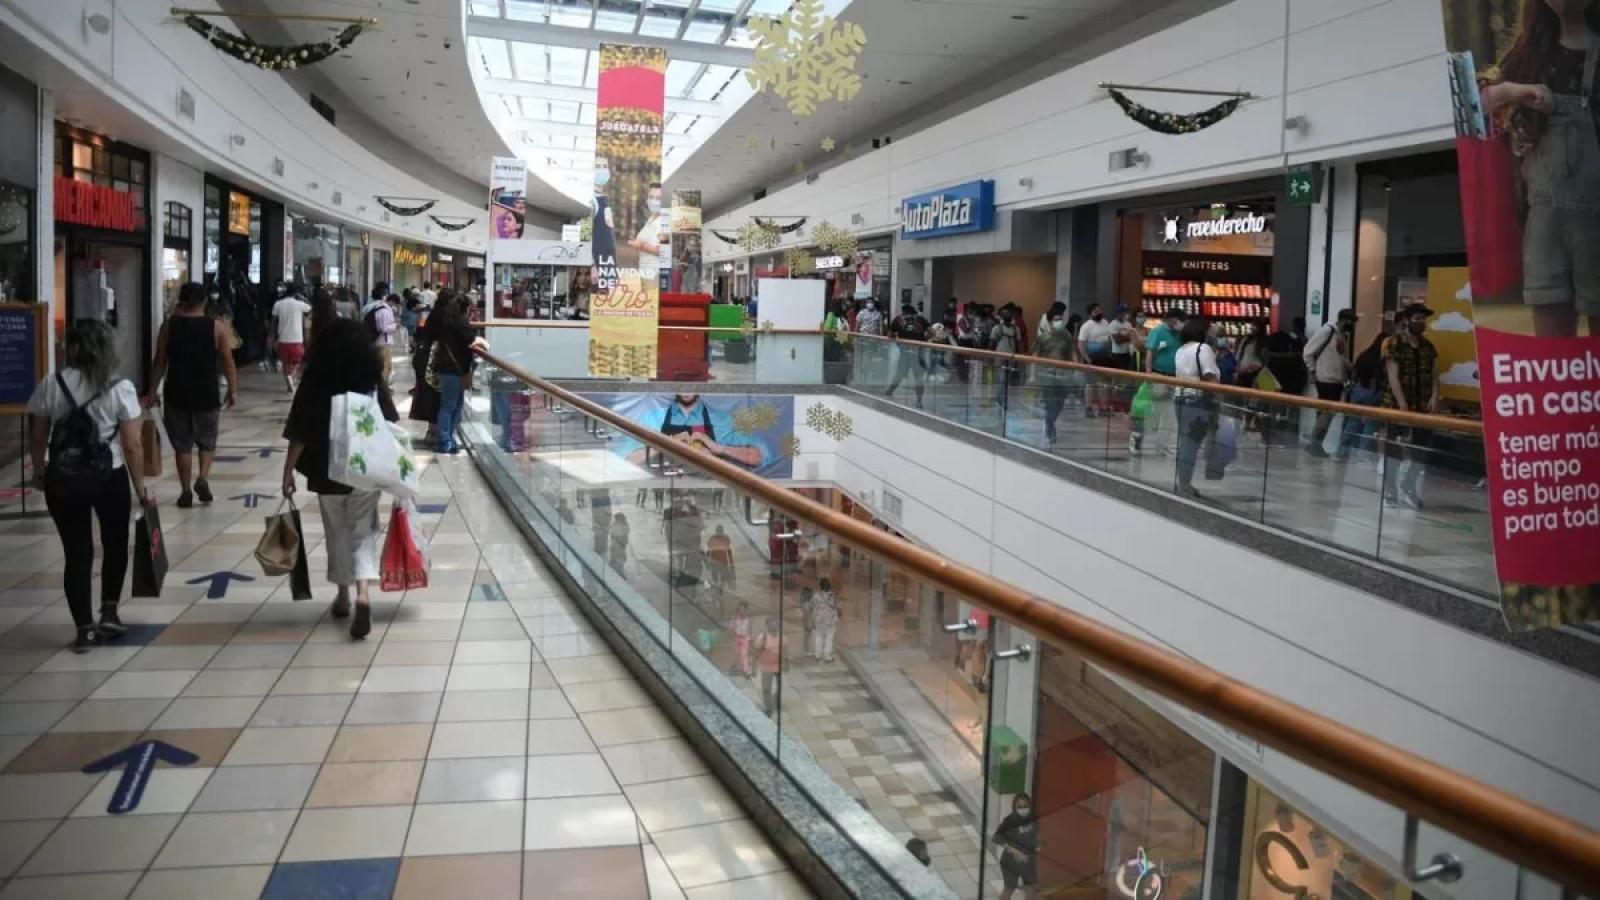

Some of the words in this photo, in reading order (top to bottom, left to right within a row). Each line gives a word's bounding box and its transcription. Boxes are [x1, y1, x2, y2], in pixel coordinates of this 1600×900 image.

[899, 193, 971, 233] AutoPlaza
[599, 254, 615, 265] LA
[1182, 260, 1231, 272] KNITTERS
[598, 266, 656, 281] NAVIDAD
[1495, 391, 1536, 417] en
[1498, 431, 1561, 454] tener
[1565, 424, 1600, 450] má
[1500, 456, 1582, 483] tiempo
[1503, 488, 1529, 507] es
[1533, 481, 1600, 505] bueno
[1505, 512, 1558, 540] para
